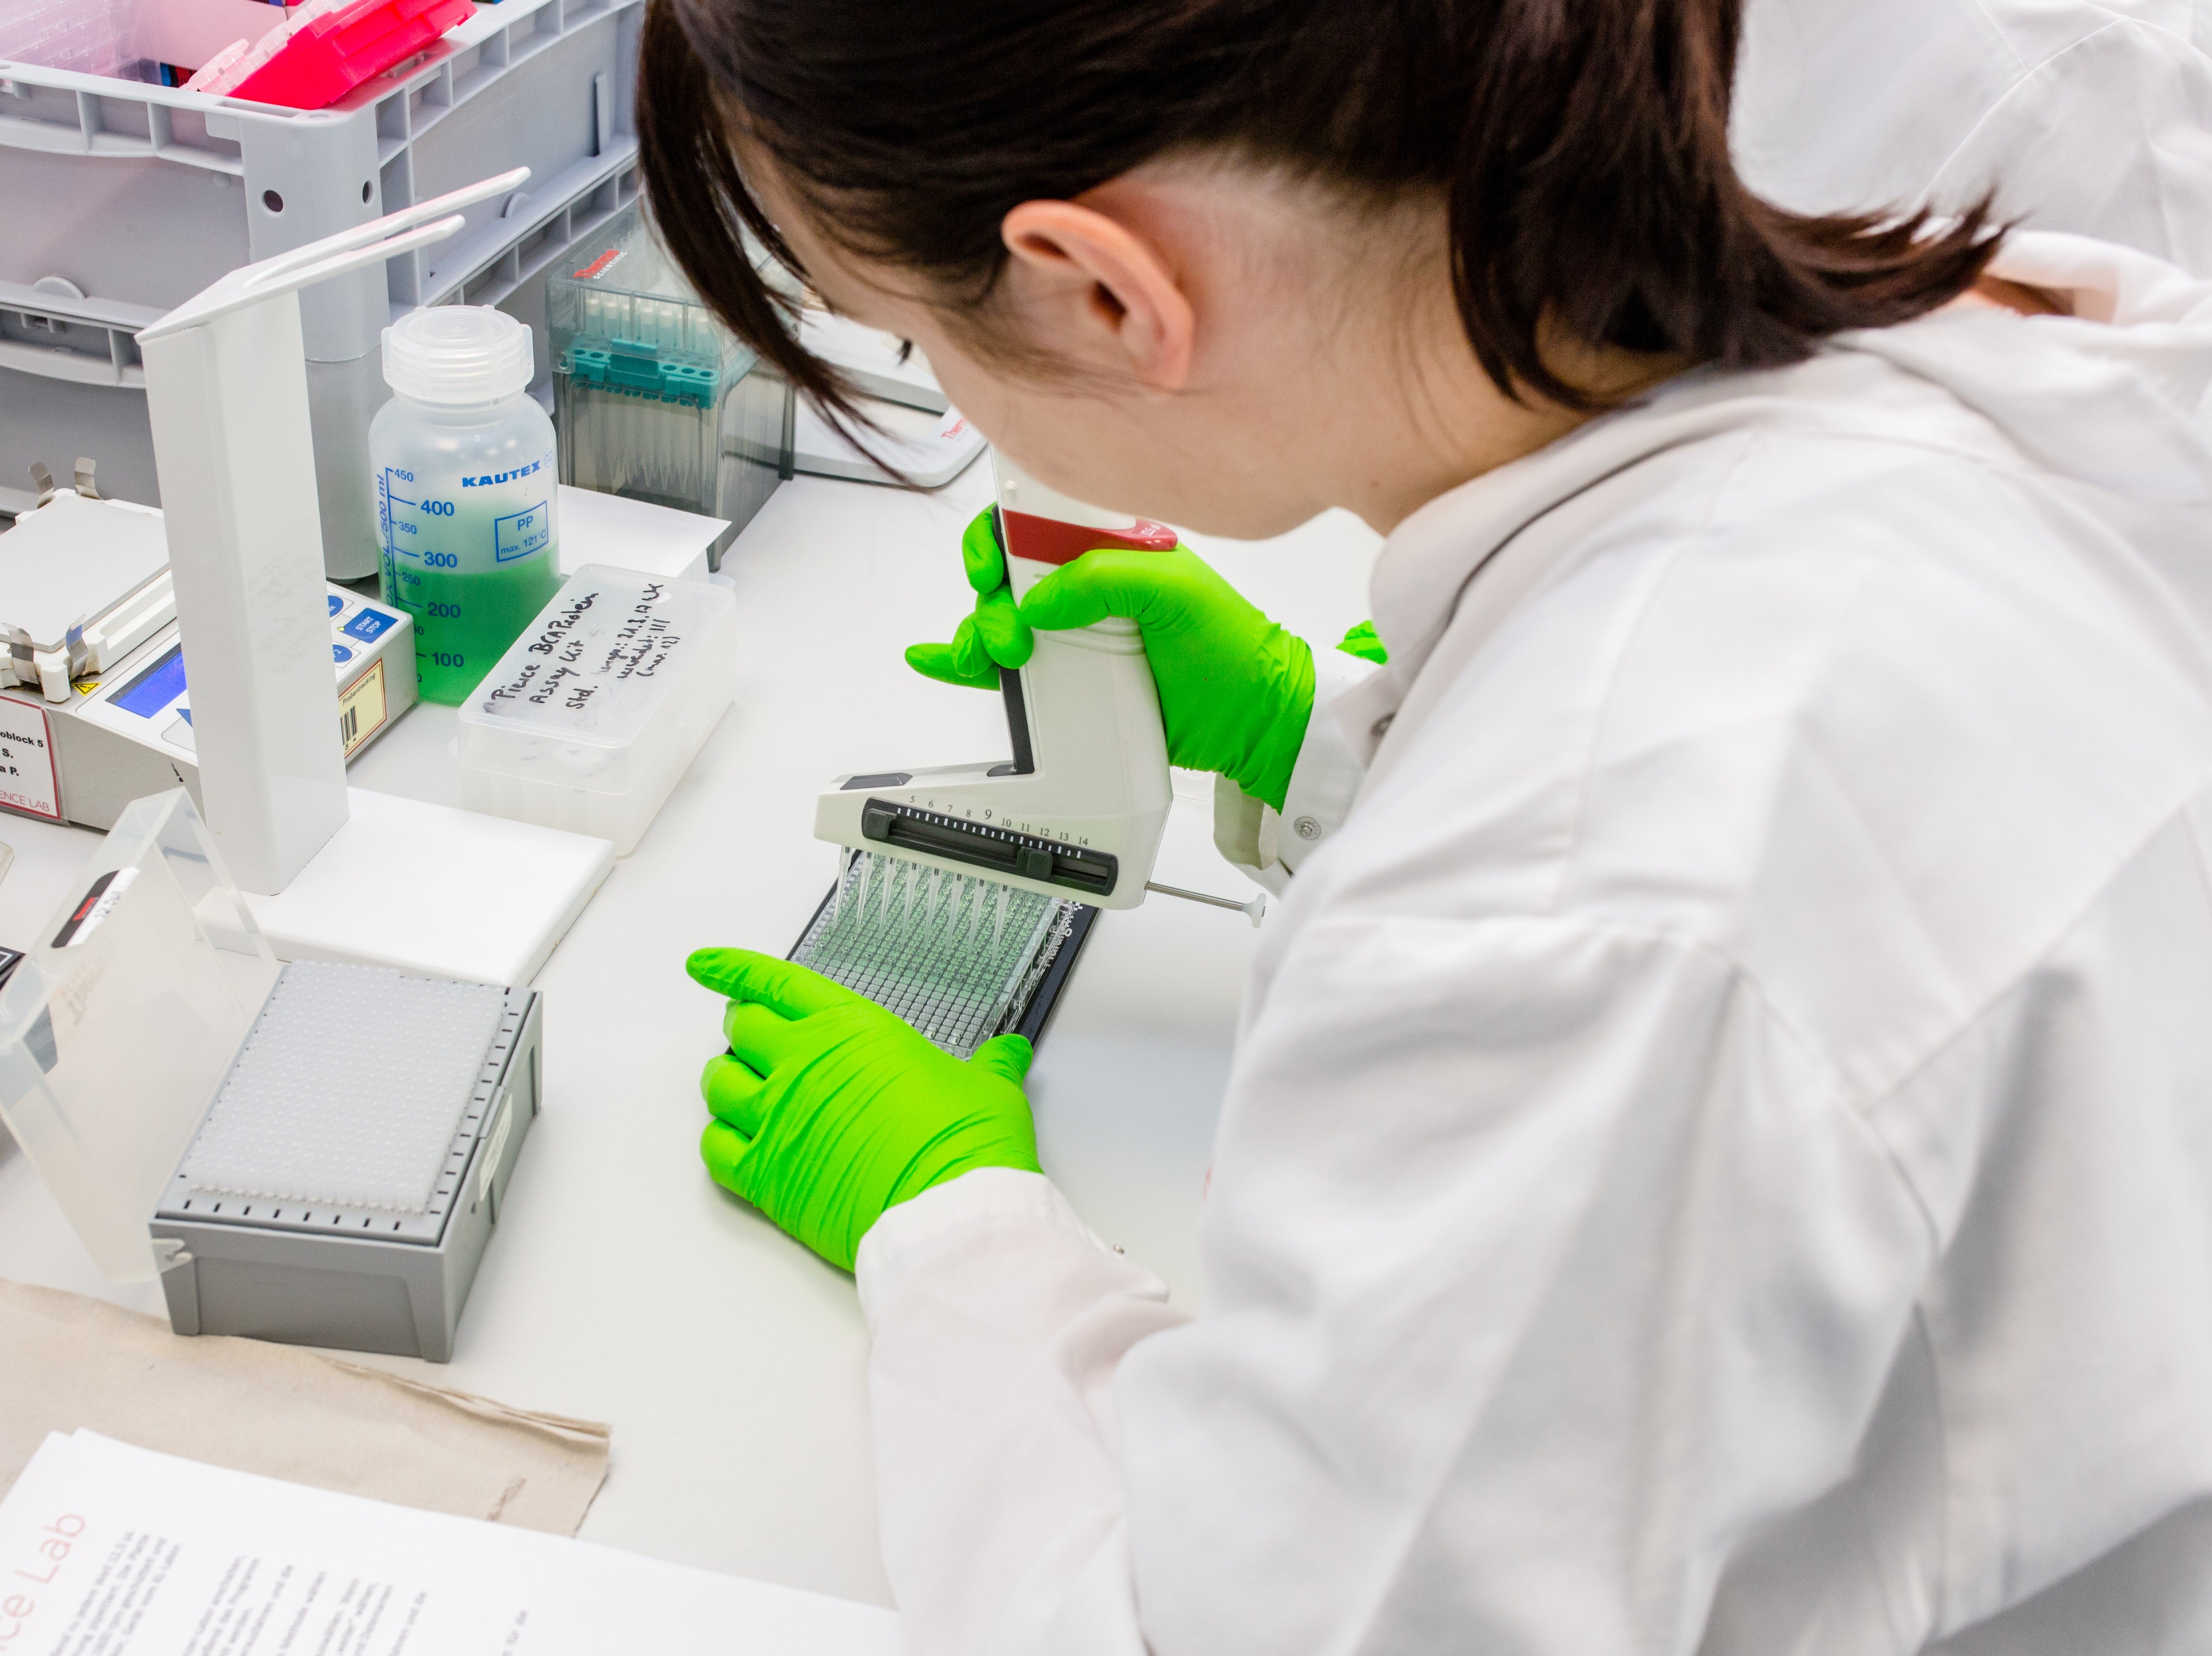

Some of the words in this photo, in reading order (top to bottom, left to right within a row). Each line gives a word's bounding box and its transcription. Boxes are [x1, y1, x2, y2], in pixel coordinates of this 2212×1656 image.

[593, 251, 628, 279] SCIENTIFIC
[394, 468, 413, 482] 450
[462, 460, 542, 487] KAUTEX
[421, 500, 455, 516] 400
[399, 521, 417, 534] 350
[518, 515, 533, 531] PP
[501, 545, 521, 554] max.
[424, 551, 458, 568] 300
[402, 572, 421, 586] 250
[428, 602, 461, 618] 200
[355, 616, 374, 631] START
[366, 621, 381, 634] STOP
[432, 652, 464, 668] 100
[343, 673, 376, 706] Probentracking
[529, 667, 581, 704] Assay
[2, 748, 13, 758] S.
[10, 766, 19, 776] P.
[29, 798, 50, 811] LAB
[928, 799, 934, 808] 6
[984, 809, 992, 819] 9
[1001, 818, 1011, 827] 10
[1021, 823, 1029, 832] 11
[1040, 828, 1050, 836] 12
[1059, 832, 1069, 841] 13
[1079, 836, 1088, 845] 14
[14, 1513, 86, 1584] Lab
